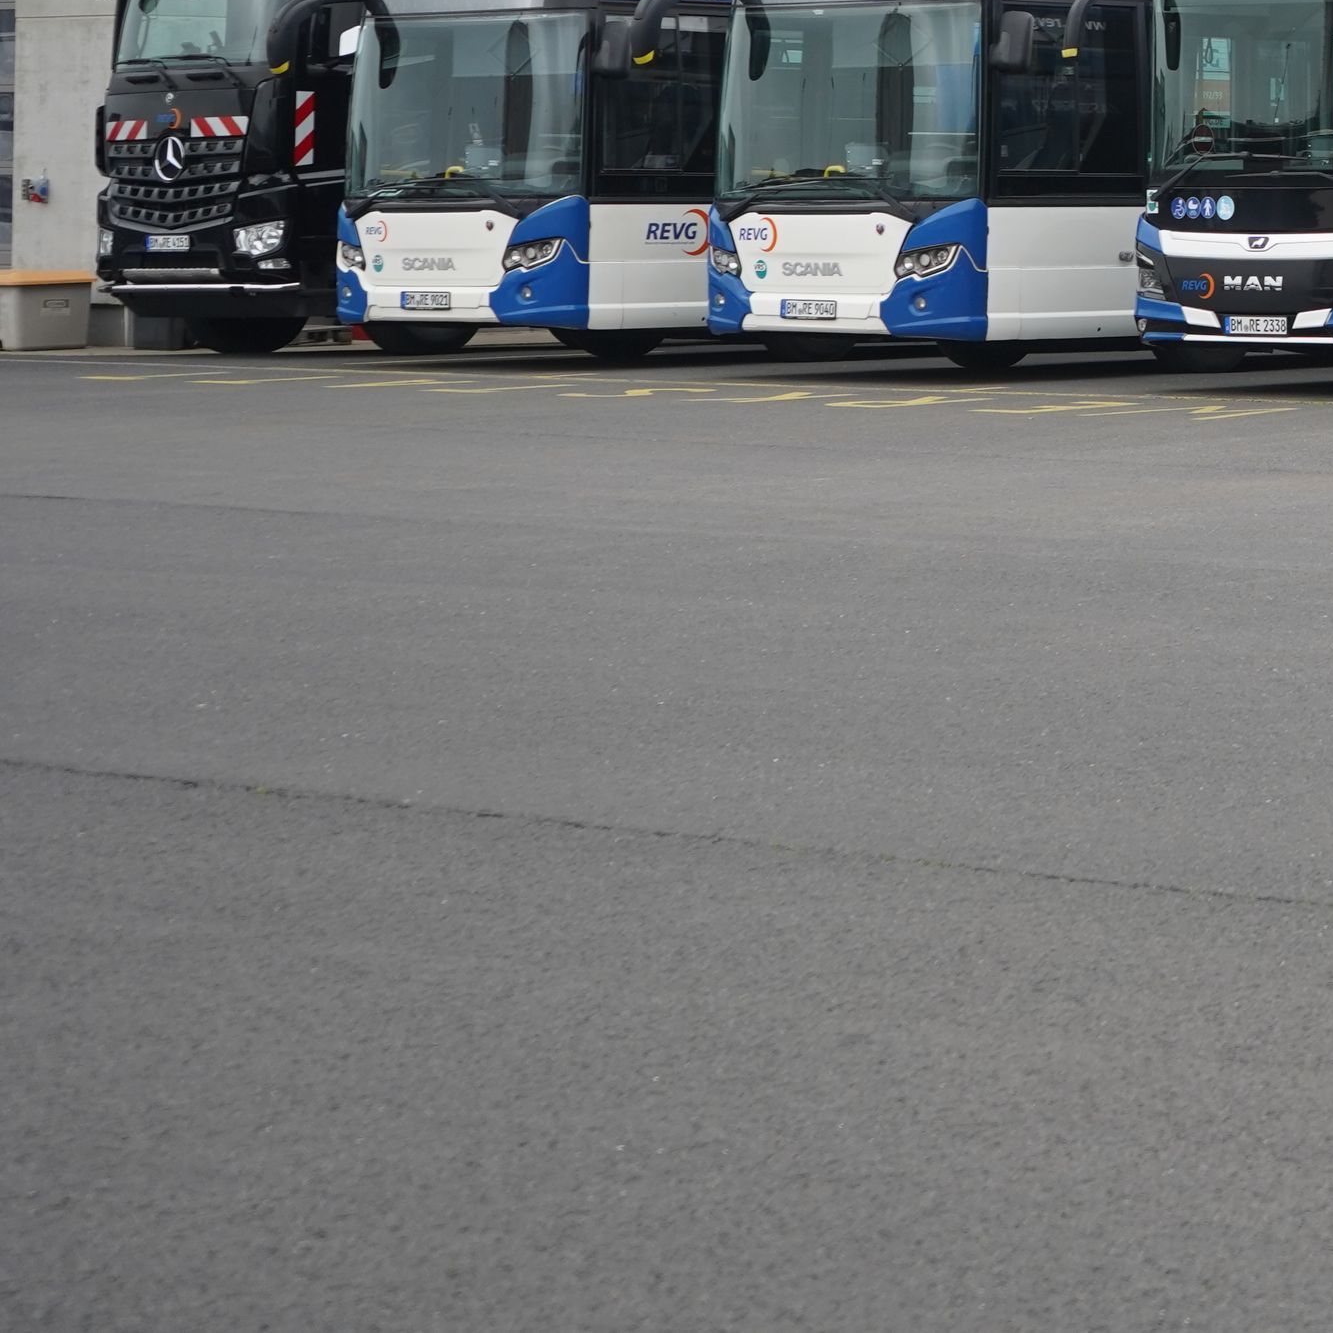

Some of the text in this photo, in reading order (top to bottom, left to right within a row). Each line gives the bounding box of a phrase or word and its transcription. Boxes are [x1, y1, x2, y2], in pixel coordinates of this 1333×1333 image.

[645, 222, 698, 240] REVG
[739, 227, 769, 241] REVG
[402, 258, 456, 271] SCANIA
[782, 262, 843, 276] SCANIA
[1182, 280, 1208, 291] REVG
[1223, 275, 1284, 291] MAN
[786, 302, 797, 315] BM
[802, 303, 813, 315] RE
[1230, 319, 1287, 333] BM RE 2338
